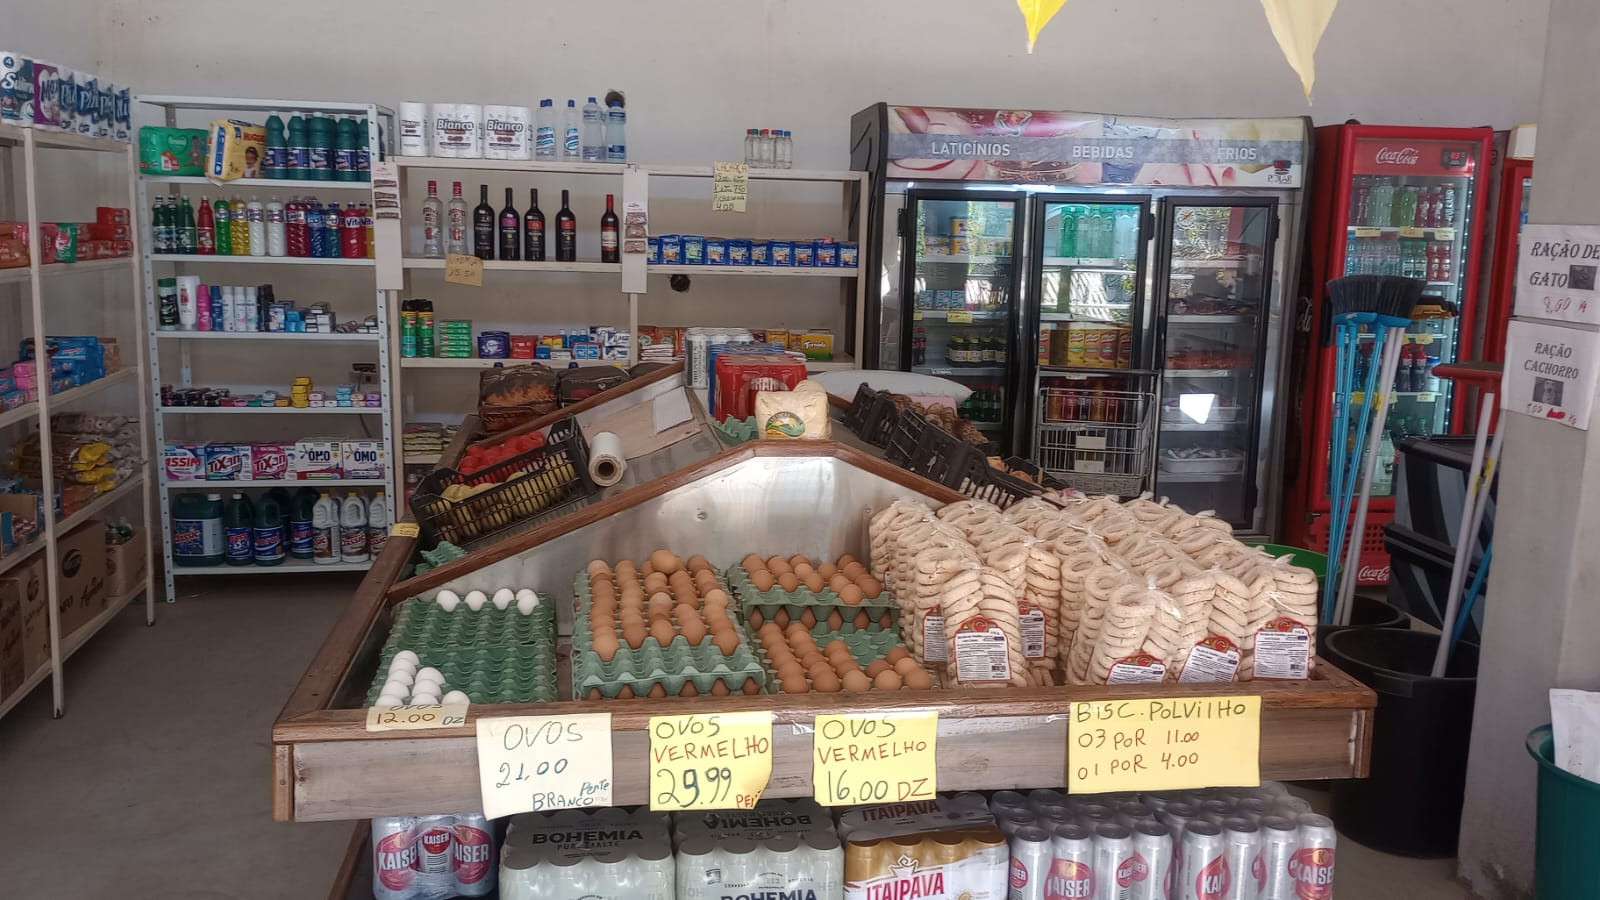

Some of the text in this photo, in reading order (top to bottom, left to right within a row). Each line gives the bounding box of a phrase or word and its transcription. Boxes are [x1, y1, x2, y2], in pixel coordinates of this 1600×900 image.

[437, 119, 474, 131] Bianco
[487, 120, 523, 132] Bianco
[931, 141, 1010, 156] LATICÍNIOS
[1072, 146, 1133, 158] BEBIDAS
[1217, 147, 1256, 160] FRIOS
[1531, 239, 1600, 261] RAÇÃO DE
[1529, 272, 1568, 288] GATO
[1535, 342, 1572, 359] RAÇÃO
[1524, 359, 1579, 380] CACHORRO
[377, 712, 436, 725] 12.00
[656, 716, 720, 739] OVOS
[823, 716, 896, 739] OVOS
[503, 721, 583, 750] OVOS
[1078, 729, 1106, 748] 03
[654, 735, 769, 764] VERMELHO
[818, 741, 927, 765] VERMELHO
[1077, 763, 1098, 779] 01
[1161, 752, 1198, 769] 4.00
[897, 778, 933, 801] DZ
[532, 792, 594, 811] BRANCO
[862, 800, 941, 822] ITAIPAVA
[424, 832, 450, 845] KAISER
[532, 830, 644, 844] BOHEMIA
[866, 872, 945, 900] ITAIPAVA
